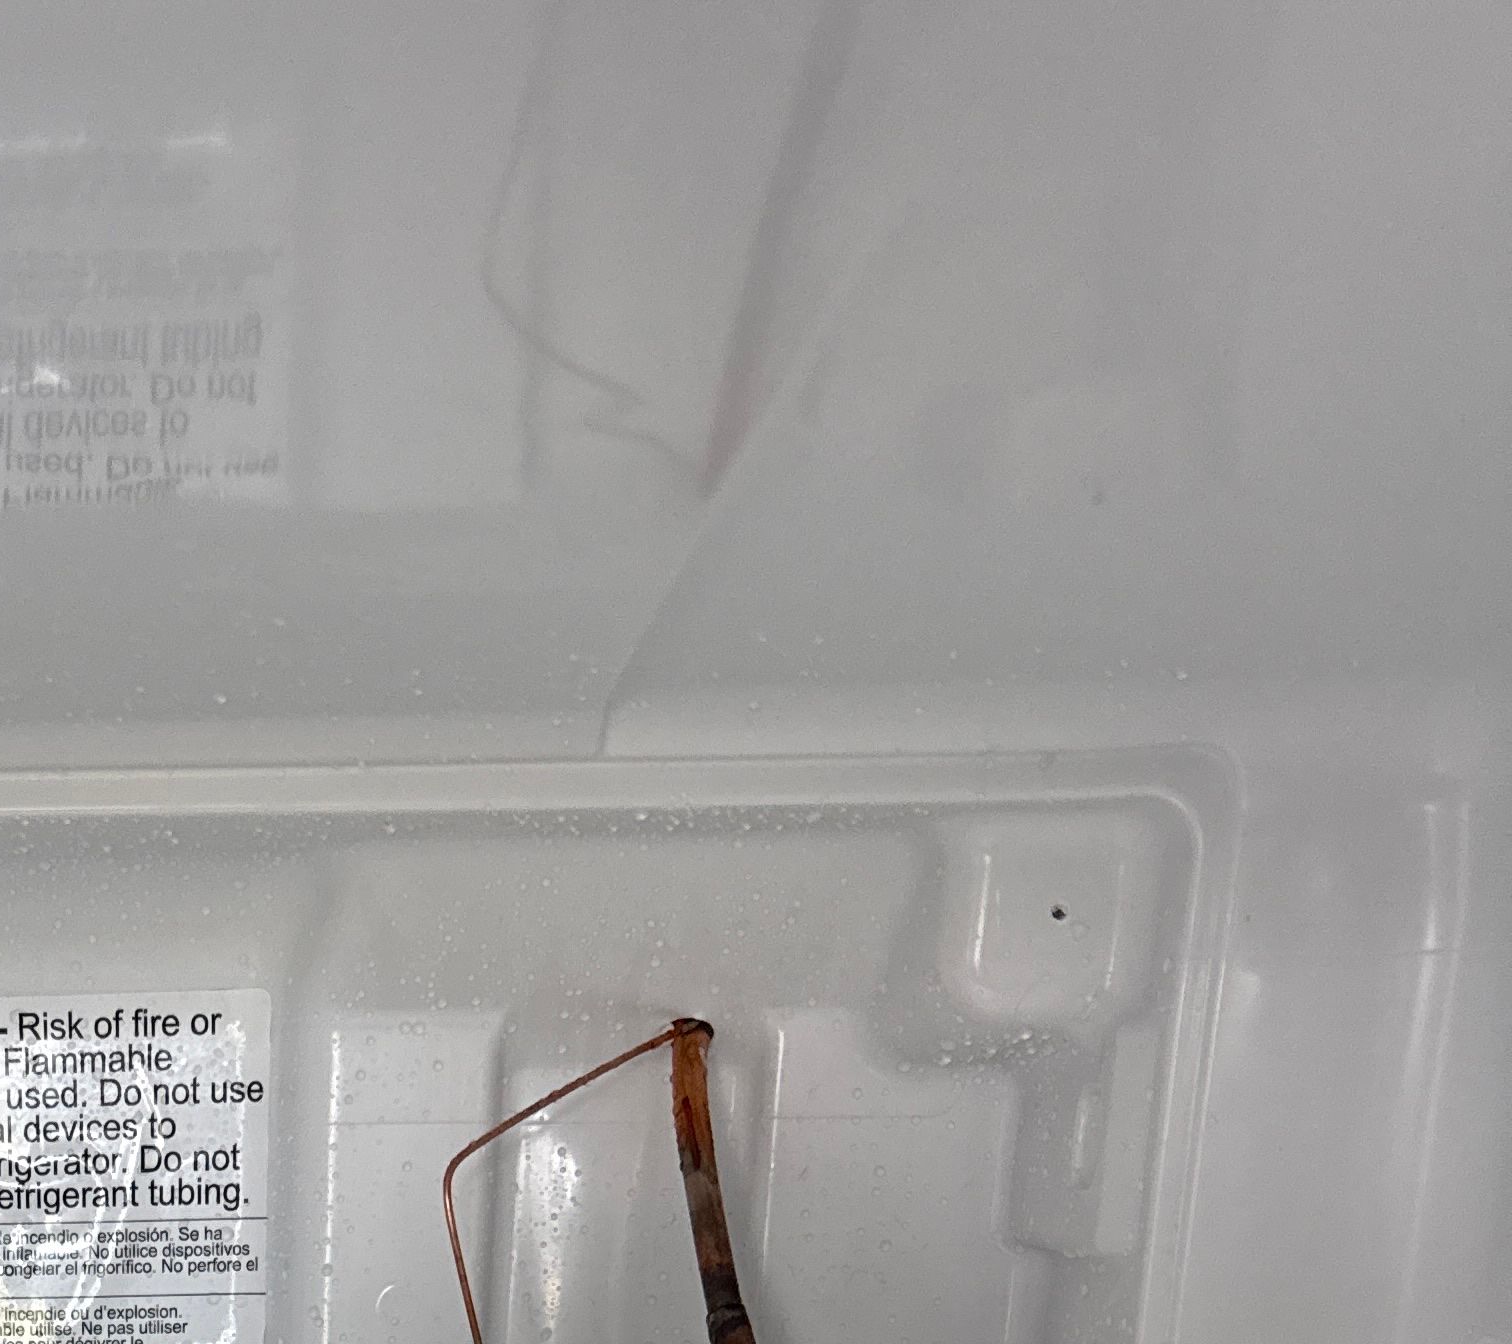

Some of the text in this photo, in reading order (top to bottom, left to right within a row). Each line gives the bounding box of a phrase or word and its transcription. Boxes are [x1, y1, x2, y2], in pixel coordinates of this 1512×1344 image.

[19, 1011, 84, 1040] Risk
[94, 1009, 123, 1038] of
[132, 1009, 180, 1037] fire
[191, 1012, 222, 1035] or
[5, 1044, 172, 1077] Flammable
[7, 1079, 87, 1109] used.
[100, 1079, 141, 1106] Do
[154, 1077, 200, 1104] not
[211, 1080, 264, 1103] use
[23, 1113, 138, 1144] devices
[149, 1112, 176, 1139] to
[141, 1145, 182, 1173] Do
[193, 1143, 241, 1171] not
[148, 1177, 249, 1211] tubing.
[178, 1226, 200, 1242] Se
[204, 1226, 223, 1241] ha
[65, 1261, 78, 1275] el
[161, 1258, 183, 1273] No
[187, 1257, 241, 1276] perfore
[245, 1256, 259, 1272] el
[89, 1245, 109, 1260] No
[114, 1243, 158, 1259] utilice
[162, 1242, 250, 1260] dispositivos
[71, 1308, 89, 1320] ou
[94, 1304, 182, 1322] d'explosion.
[81, 1321, 103, 1336] Ne
[107, 1323, 135, 1338] pas
[139, 1319, 188, 1335] utiliser
